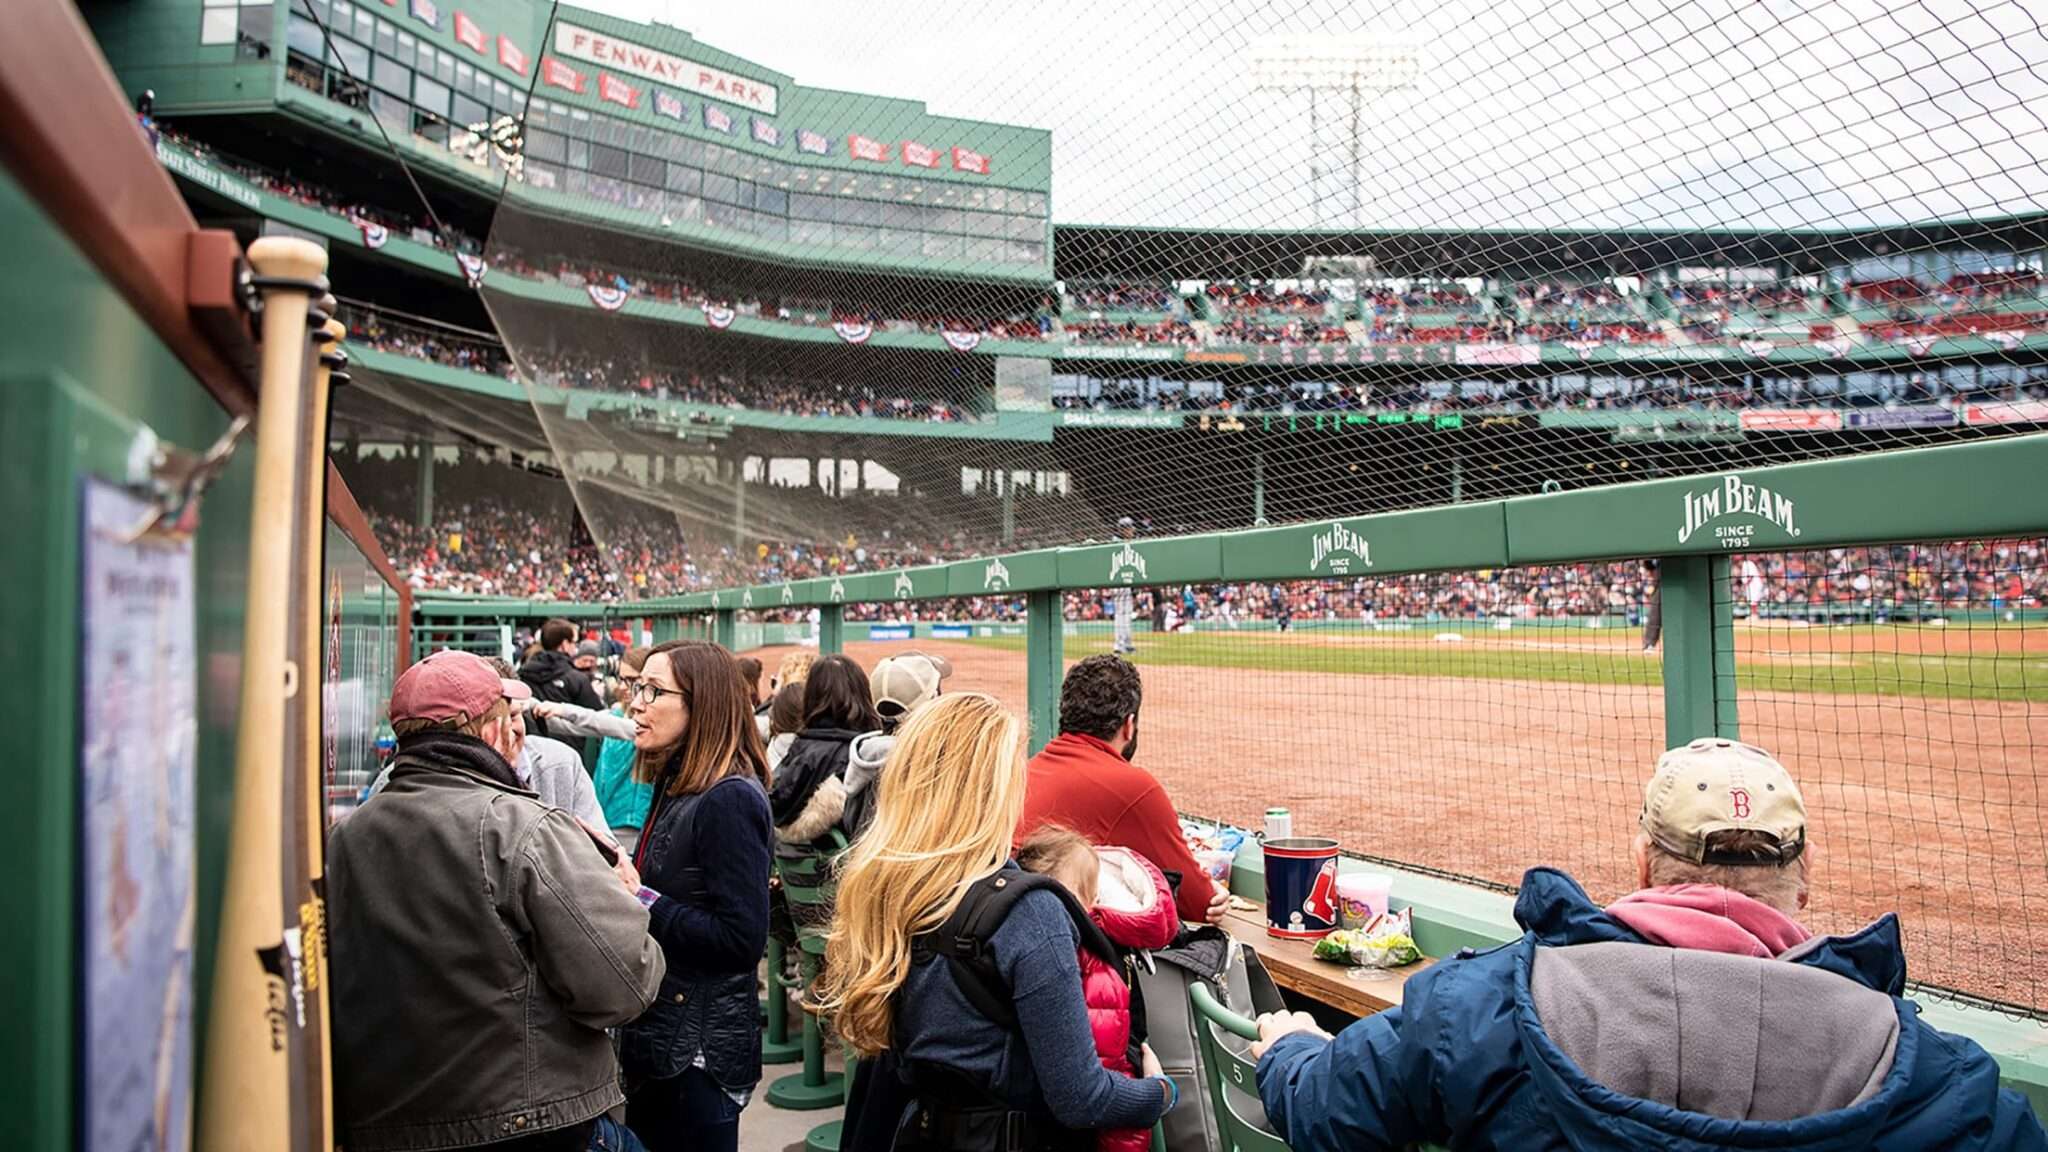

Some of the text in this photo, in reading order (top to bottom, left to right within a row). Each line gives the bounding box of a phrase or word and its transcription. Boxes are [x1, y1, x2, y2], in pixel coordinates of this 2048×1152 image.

[572, 33, 682, 80] FENWAY
[699, 72, 763, 105] PARK
[1678, 487, 1720, 543] JIM
[1715, 525, 1754, 537] SINCE
[1721, 536, 1750, 549] 1795
[1310, 522, 1370, 571] JIM BEAM
[1729, 789, 1751, 819] B
[1232, 1062, 1243, 1084] 5
